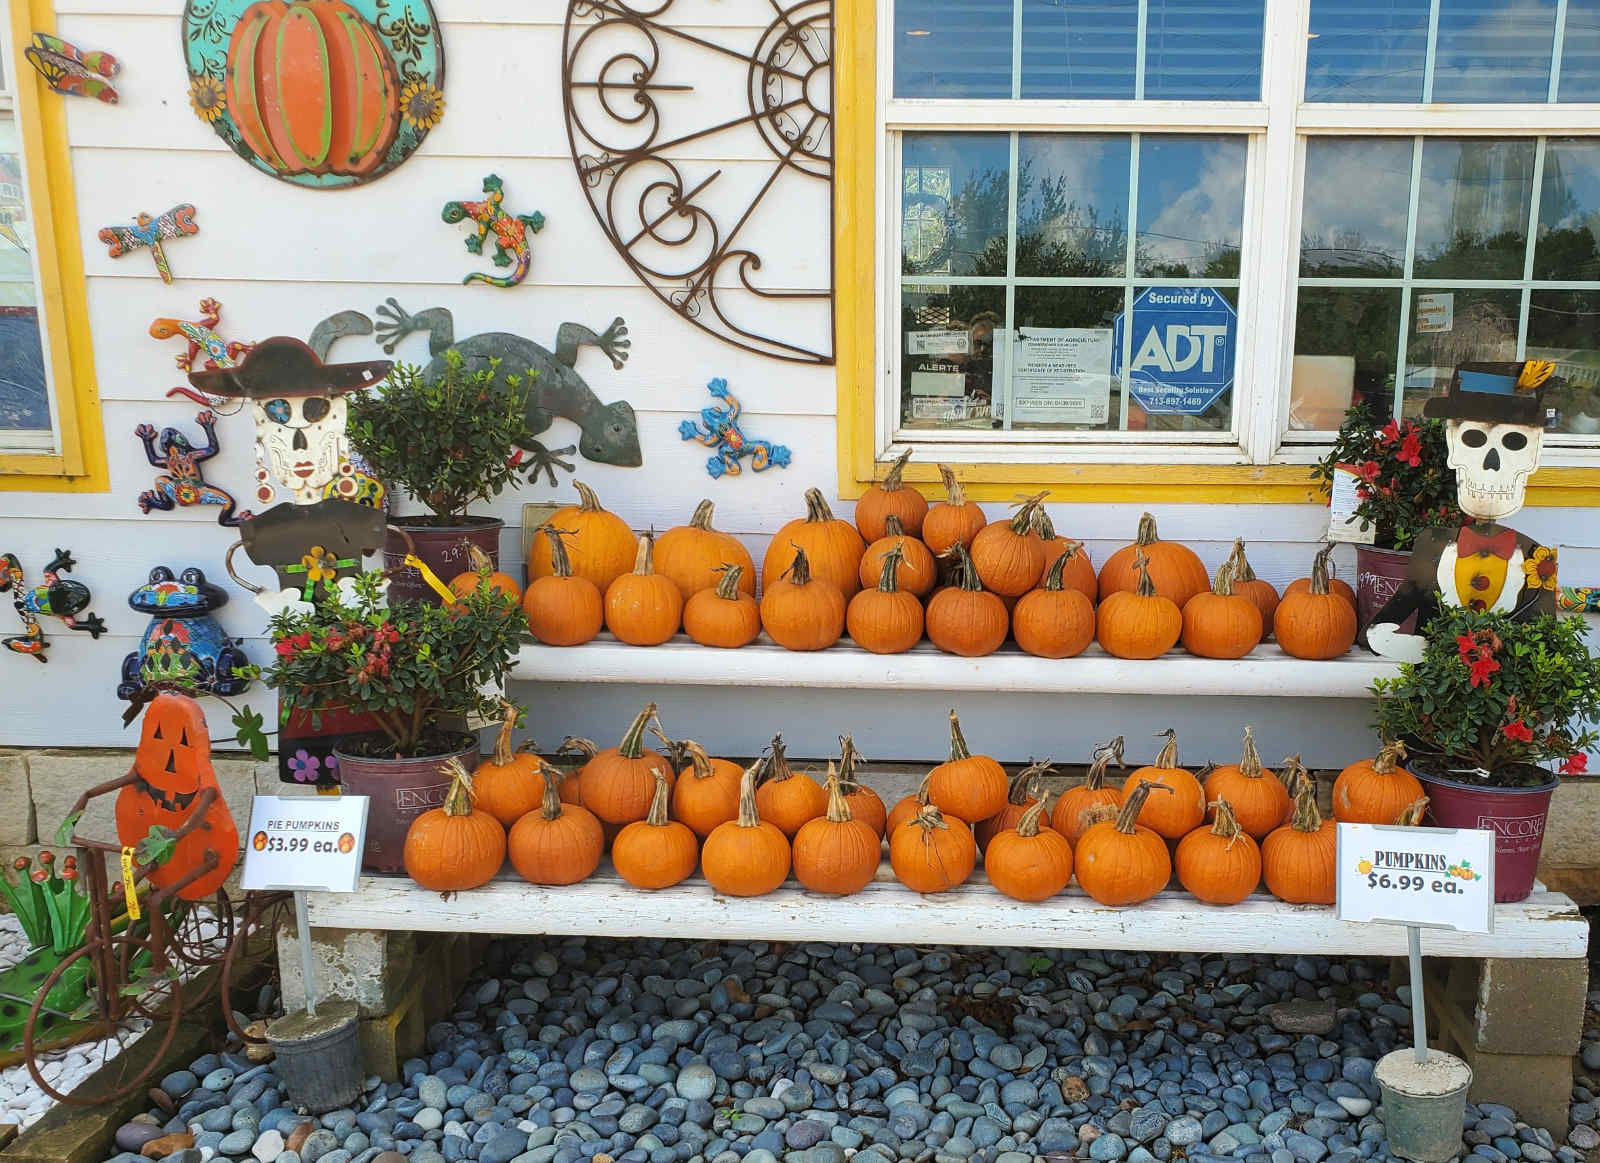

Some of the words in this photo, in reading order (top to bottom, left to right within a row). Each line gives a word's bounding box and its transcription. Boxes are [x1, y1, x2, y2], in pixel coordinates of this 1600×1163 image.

[1148, 292, 1197, 304] Secured
[1200, 292, 1214, 307] by
[267, 820, 284, 830] PIE
[286, 820, 341, 831] PUMPKINS
[267, 836, 309, 852] $3.99
[313, 840, 339, 853] ea.
[1374, 850, 1447, 871] PUMPKINS
[1367, 871, 1425, 892] $6.99
[1431, 880, 1464, 895] ea.
